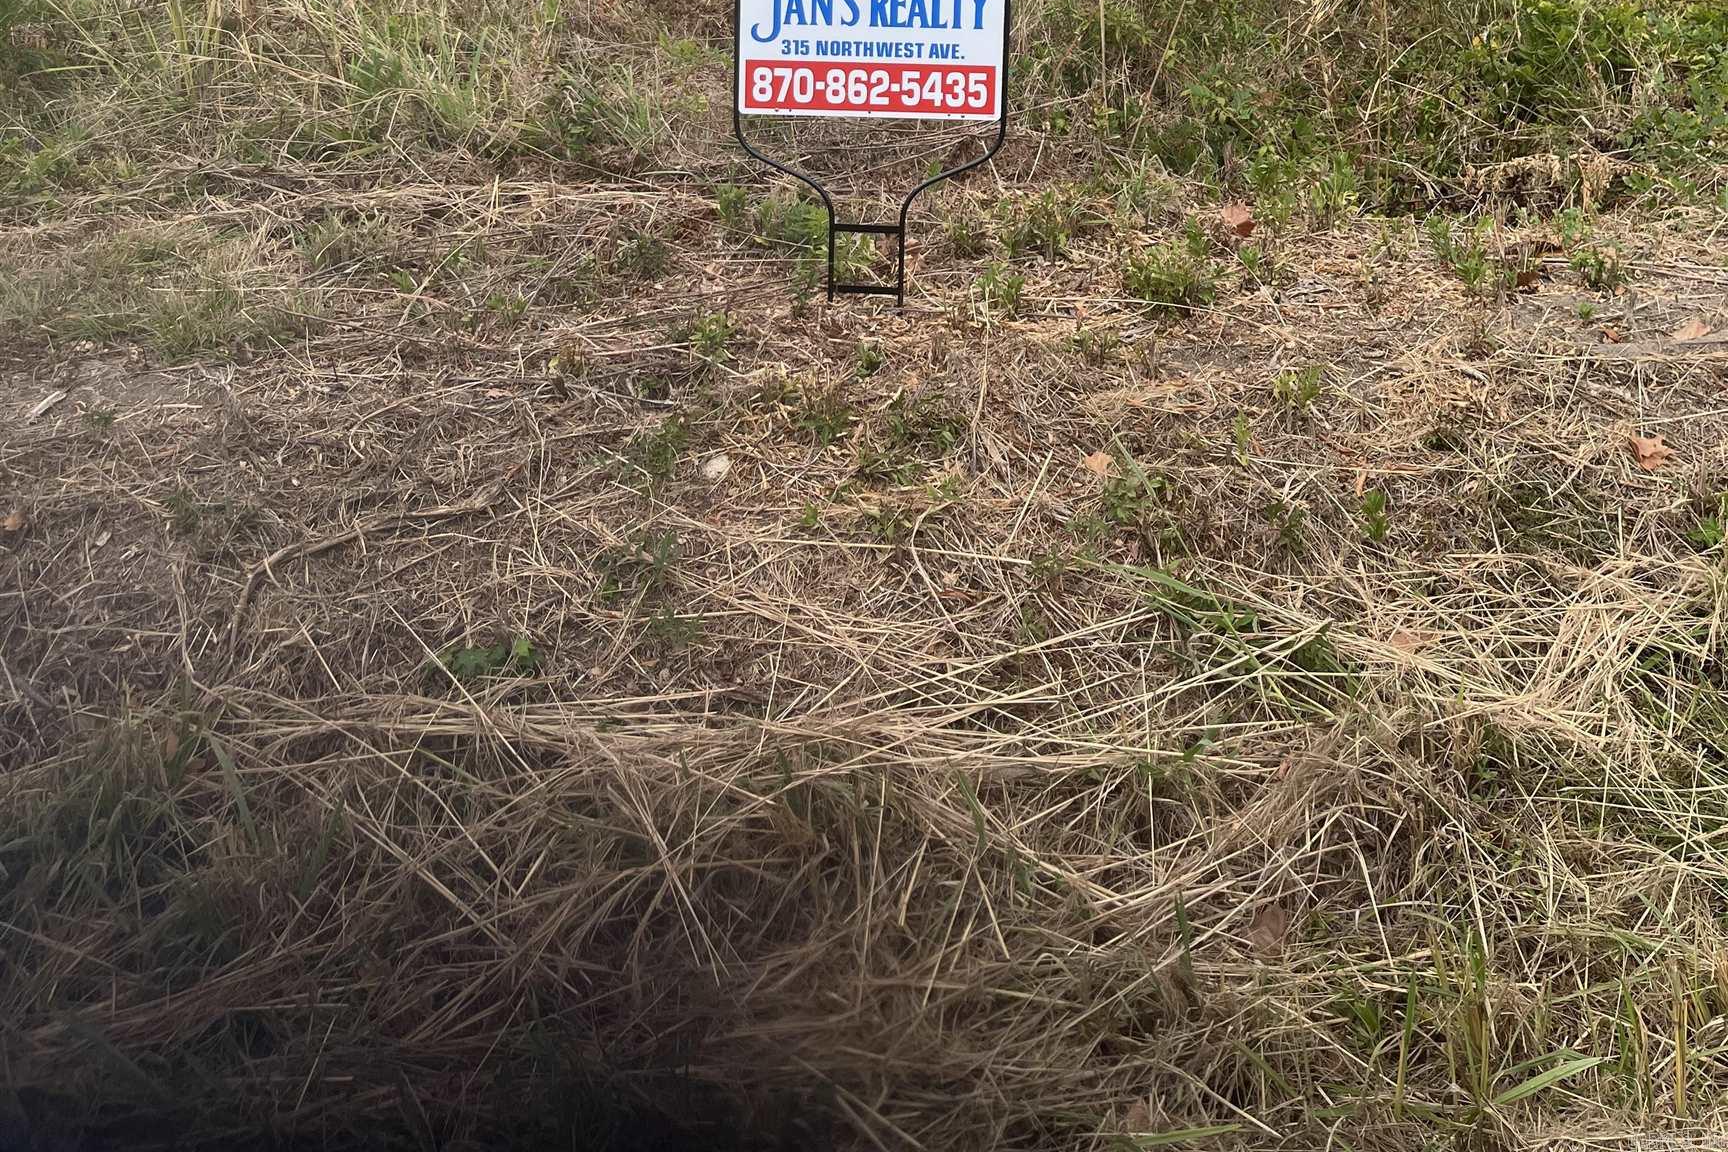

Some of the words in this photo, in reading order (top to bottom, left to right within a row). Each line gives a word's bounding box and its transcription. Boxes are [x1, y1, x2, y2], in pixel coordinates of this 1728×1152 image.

[781, 40, 809, 56] 315
[816, 40, 924, 58] NORTHWEST
[928, 43, 965, 59] AVE.
[752, 67, 987, 107] 870-862-5435
